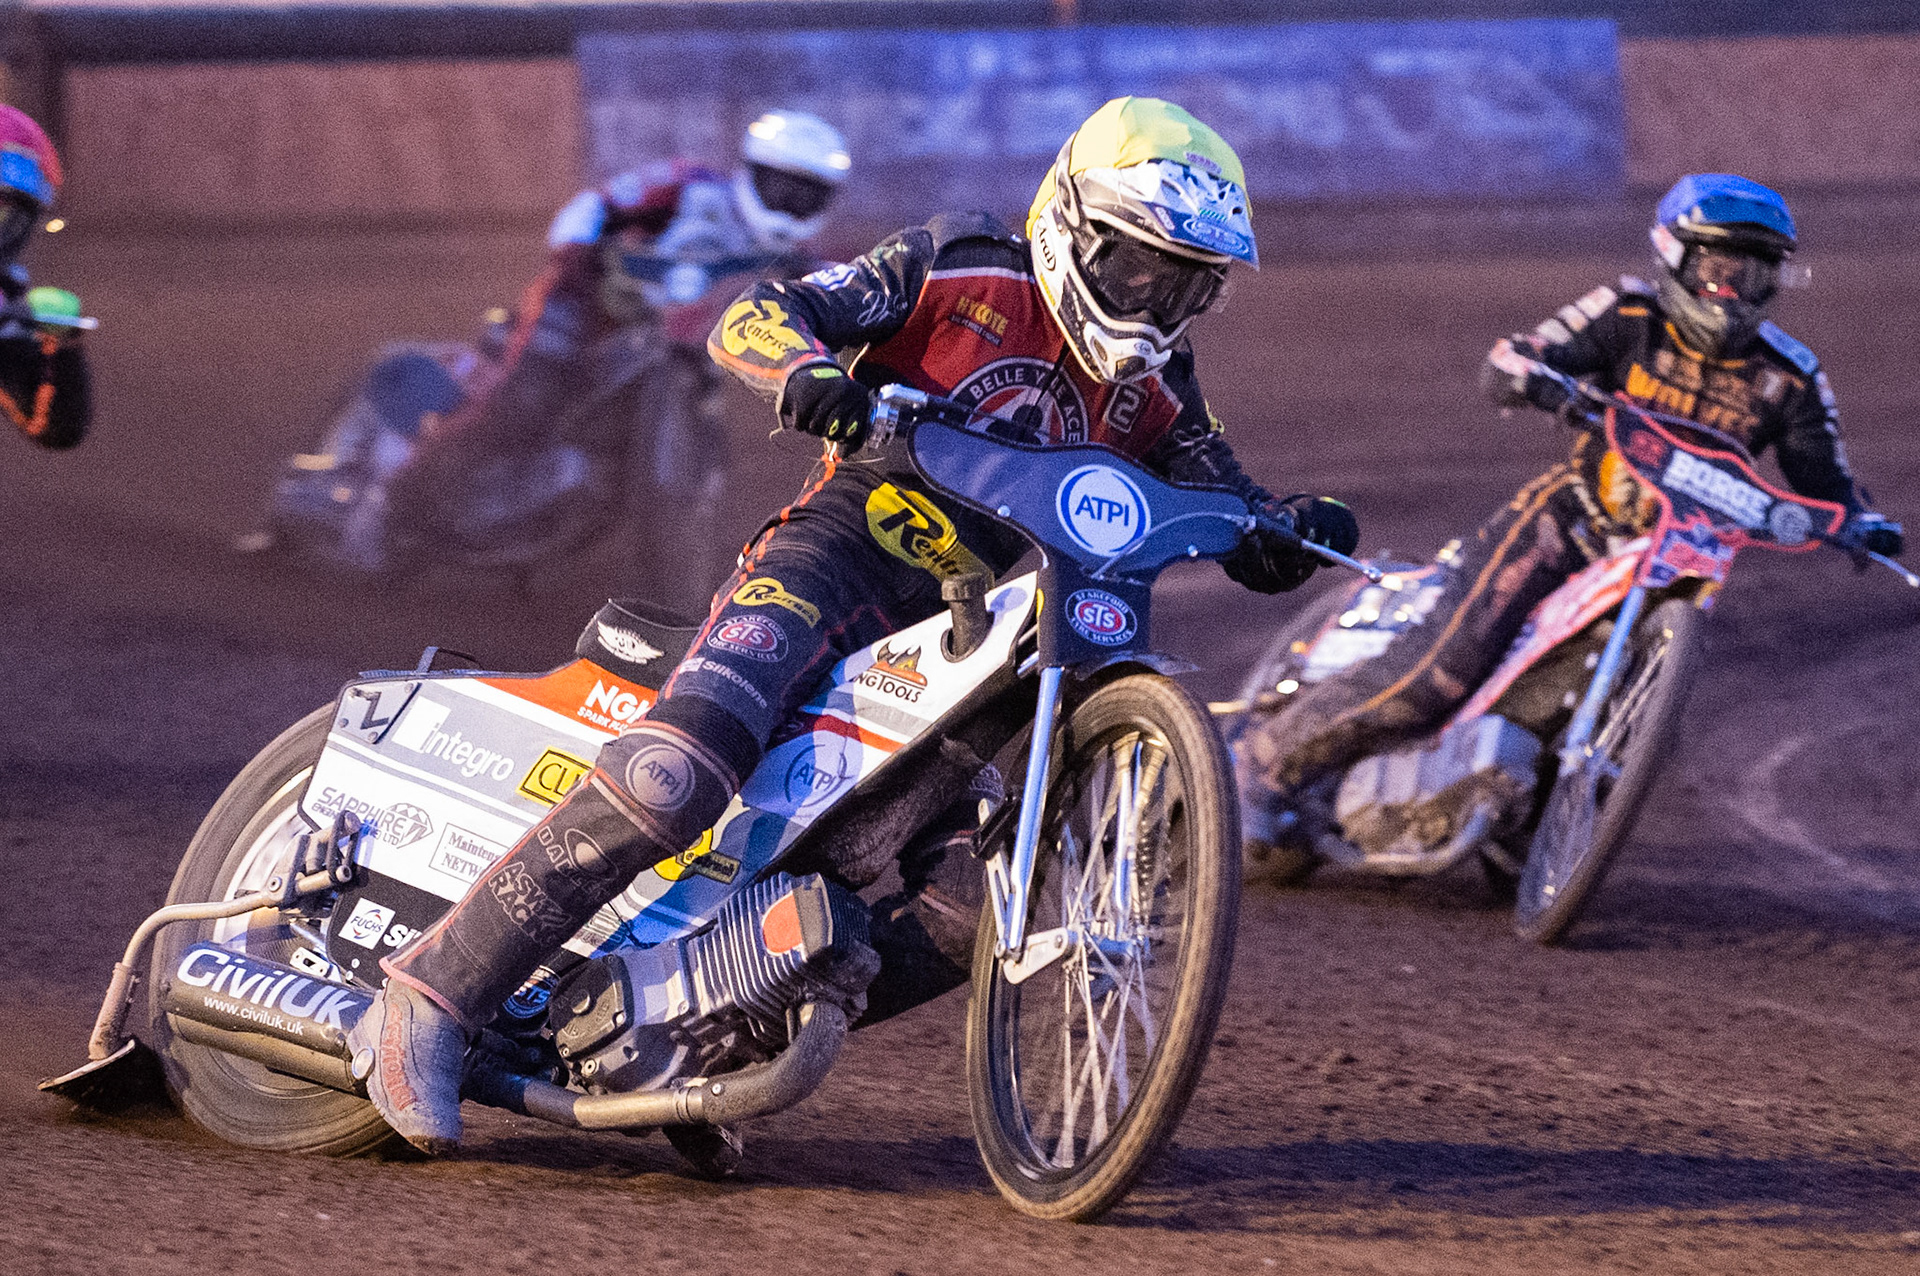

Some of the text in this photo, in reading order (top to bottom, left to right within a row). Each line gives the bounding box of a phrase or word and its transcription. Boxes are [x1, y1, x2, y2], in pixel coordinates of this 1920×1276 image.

[969, 367, 1025, 400] BELLE
[1063, 404, 1081, 443] ACE
[1074, 494, 1130, 527] ATPI
[877, 490, 961, 576] Rentr
[1082, 603, 1116, 629] STS
[725, 623, 770, 646] STS
[577, 706, 610, 728] SPARK
[420, 722, 515, 781] integro
[538, 762, 582, 798] CL
[639, 760, 681, 796] ATPI
[793, 762, 837, 792] ATPI
[317, 786, 407, 836] SAPPHIRE
[441, 852, 483, 878] NETW
[351, 915, 385, 934] FUCHS
[203, 996, 305, 1036] www.civiluk.uk
